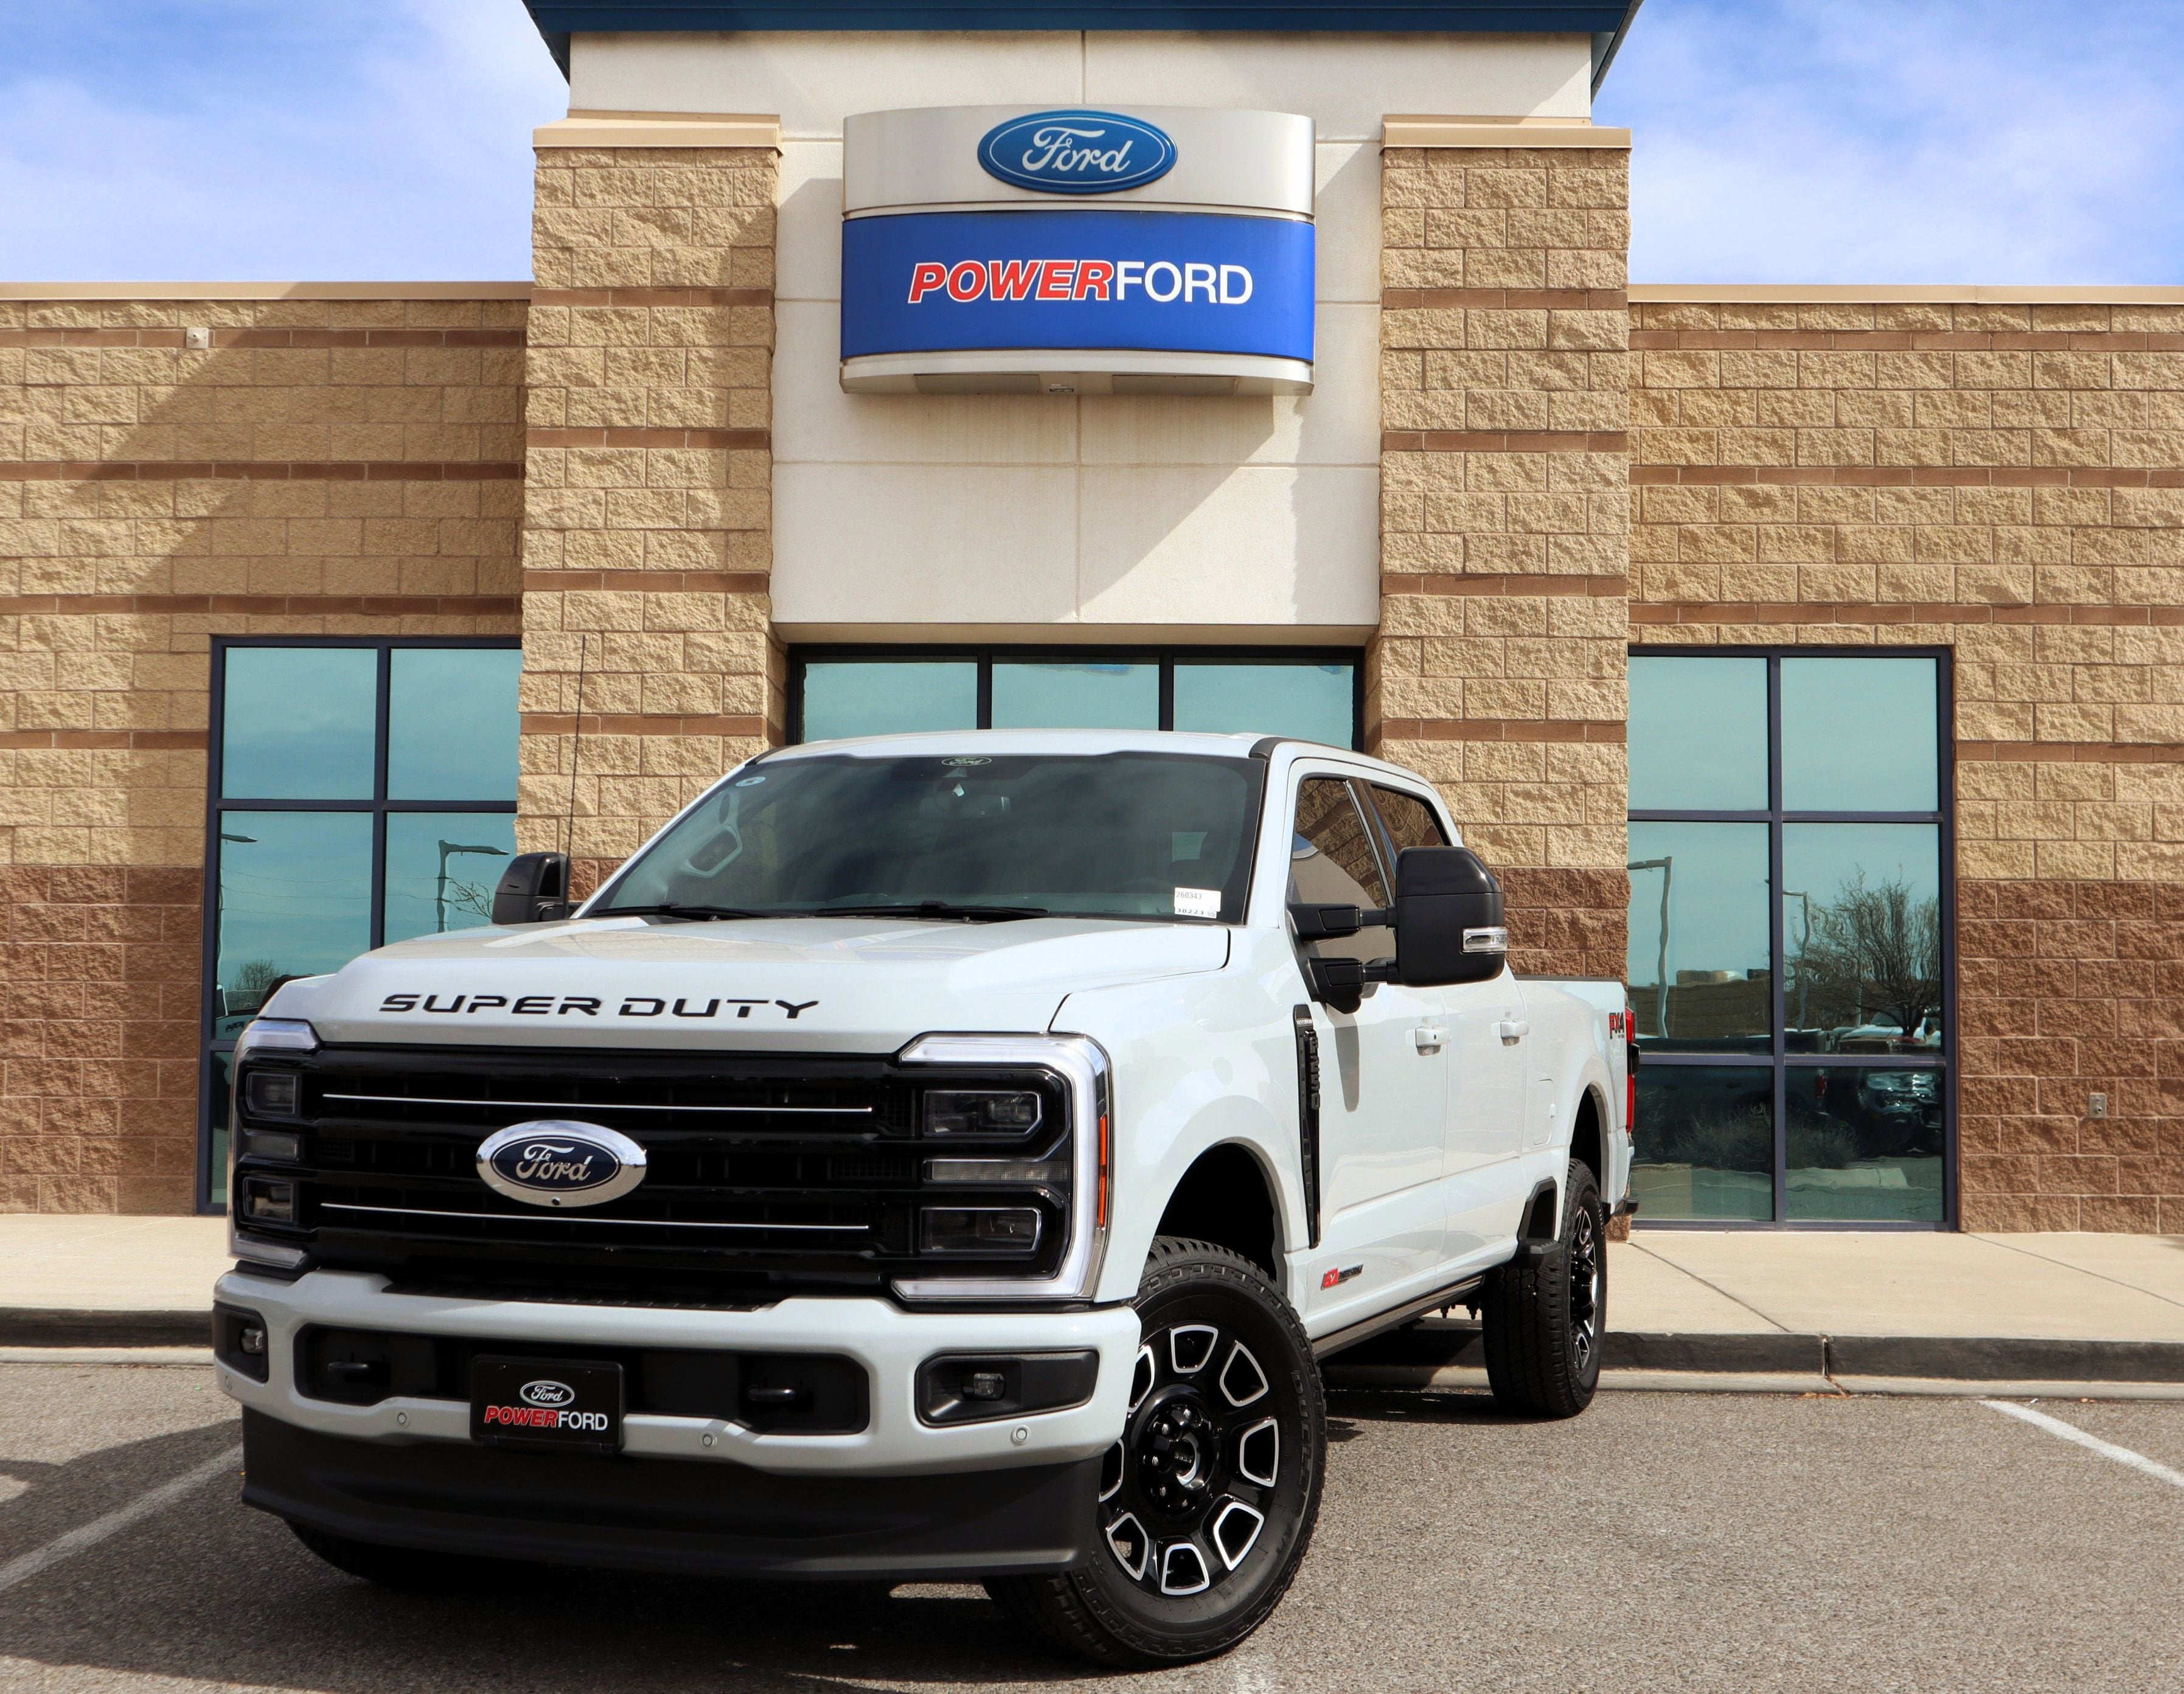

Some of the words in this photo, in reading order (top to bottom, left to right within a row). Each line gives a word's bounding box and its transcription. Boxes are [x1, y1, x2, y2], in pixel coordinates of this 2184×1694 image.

[1022, 126, 1132, 173] Ford
[1177, 891, 1202, 900] 260343
[379, 994, 605, 1016] SUPER
[619, 997, 819, 1019] DUTY
[516, 1144, 593, 1181] Ford
[530, 1385, 563, 1402] Ford
